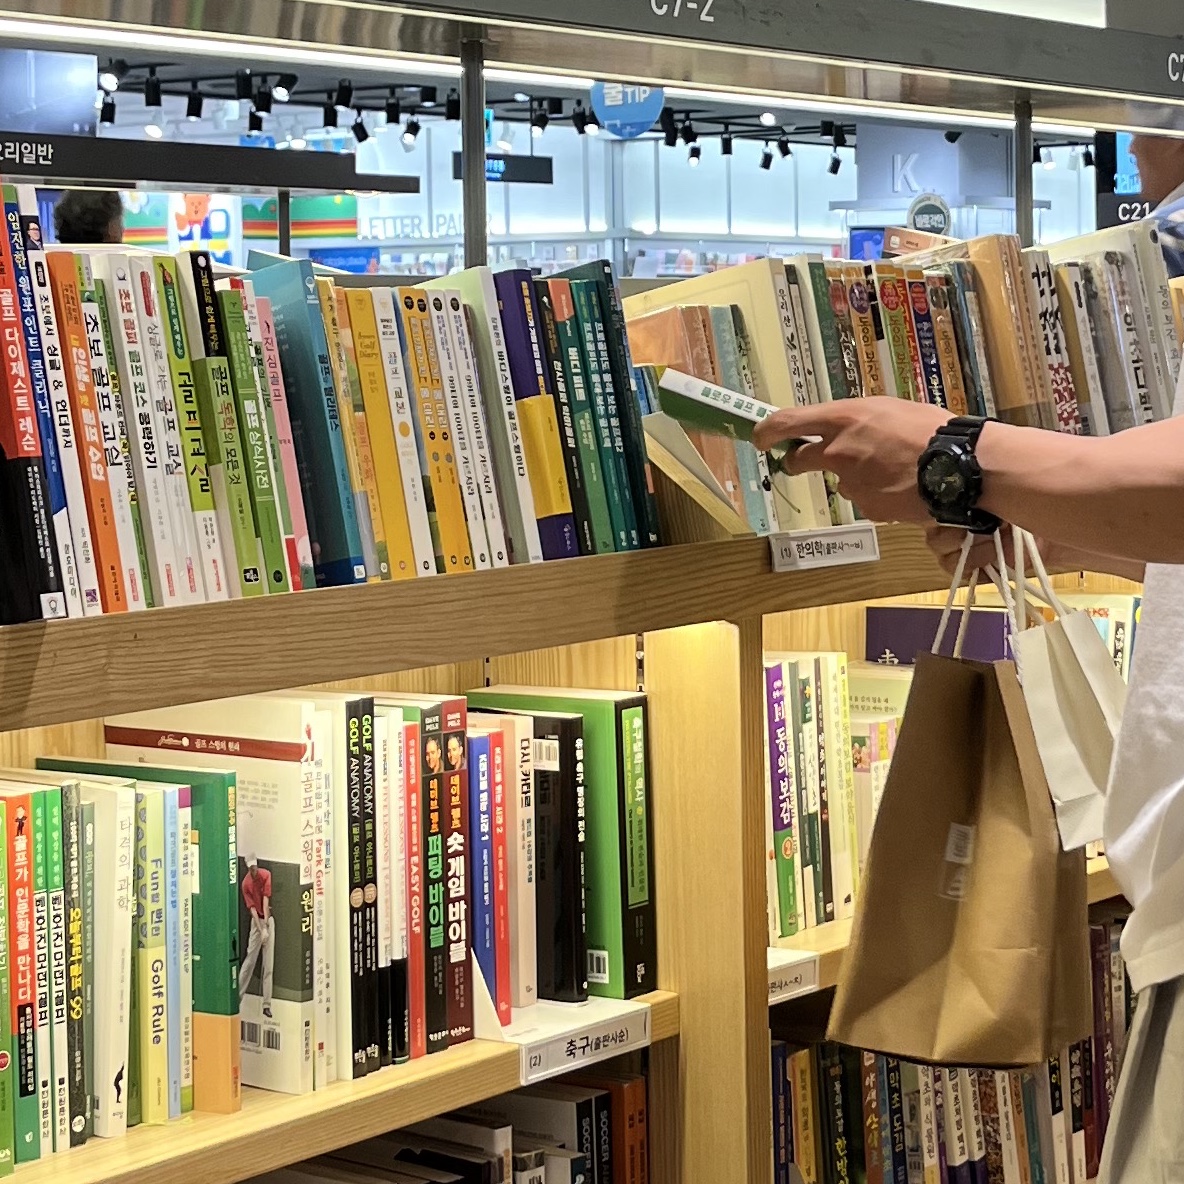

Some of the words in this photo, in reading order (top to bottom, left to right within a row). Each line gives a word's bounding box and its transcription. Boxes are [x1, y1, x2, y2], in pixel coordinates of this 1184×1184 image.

[893, 153, 921, 193] K
[8, 211, 27, 270] 임진한
[0, 287, 17, 322] 골프
[120, 289, 133, 313] 초보
[201, 270, 212, 303] 그림으로
[40, 294, 54, 336] 초보에서
[205, 306, 214, 322] 쉽게
[85, 312, 103, 359] 초보
[148, 324, 162, 361] 싱글로
[5, 327, 31, 412] 다이제스트
[46, 345, 60, 371] 싱글
[128, 350, 143, 377] 골프
[568, 347, 581, 372] 버디
[53, 380, 63, 391] &
[91, 366, 112, 414] 골프
[134, 381, 147, 408] 코스
[158, 366, 168, 391] 가는
[212, 365, 229, 397] 골프
[55, 400, 72, 448] 언더까지
[72, 347, 90, 391] 인생의
[88, 446, 105, 481] 수업
[156, 396, 175, 434] 골프
[217, 400, 237, 444] 독학의
[18, 417, 37, 451] 레슨
[102, 421, 122, 468] 교실
[139, 412, 157, 469] 공략하기
[165, 441, 183, 476] 교실
[225, 448, 238, 471] 모든
[249, 431, 270, 489] 상식사전
[228, 473, 242, 485] 것
[349, 718, 359, 754] GOLF
[362, 715, 372, 751] GOLF
[519, 739, 531, 768] 다시,
[302, 771, 315, 813] 골프
[350, 757, 360, 818] ANATOMY
[363, 754, 373, 814] ANATOMY
[450, 775, 460, 805] 데이브
[521, 770, 531, 807] 카타르
[774, 728, 793, 825] 동의보감
[119, 807, 133, 860] 타격의
[315, 838, 324, 866] Park
[447, 832, 465, 853] 숏
[13, 834, 30, 883] 골프가
[410, 856, 419, 893] EASY
[427, 835, 443, 879] 퍼팅
[118, 866, 131, 902] 과학
[315, 869, 325, 897] Golf
[447, 856, 465, 898] 게임
[15, 886, 32, 951] 인문학을
[301, 889, 314, 935] 원리
[411, 895, 420, 934] GOLF
[429, 882, 443, 948] 바이블
[449, 901, 466, 963] 바이블
[17, 955, 33, 1000] 만나다
[151, 958, 164, 999] Golf
[69, 996, 83, 1021] 99
[151, 1005, 164, 1045] Rule
[529, 1053, 541, 1068] (2)
[582, 1117, 592, 1168] SOCCER
[600, 1111, 610, 1162] SOCCER
